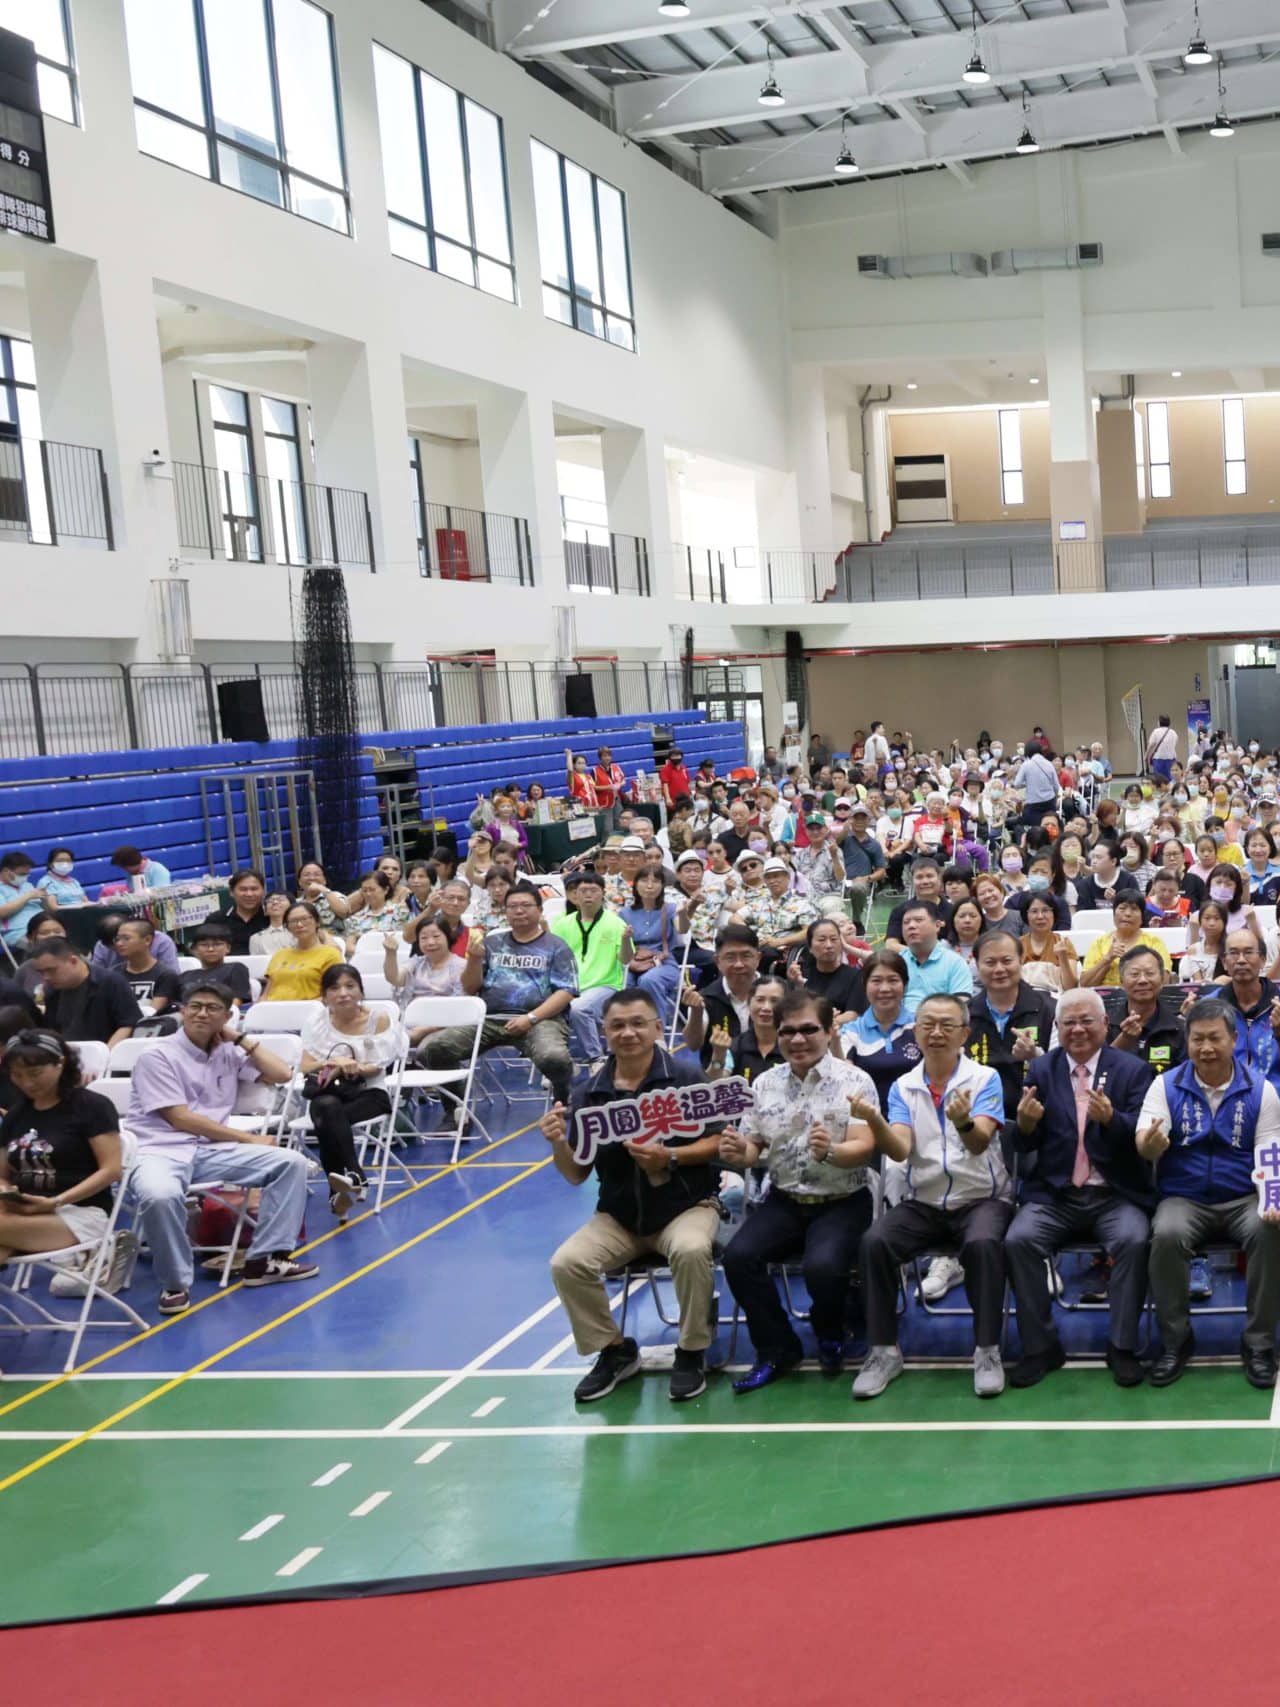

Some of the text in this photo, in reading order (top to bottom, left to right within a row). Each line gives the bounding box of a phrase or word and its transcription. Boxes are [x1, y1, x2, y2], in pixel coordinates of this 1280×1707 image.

[579, 1081, 754, 1160] 月圓樂溫馨
